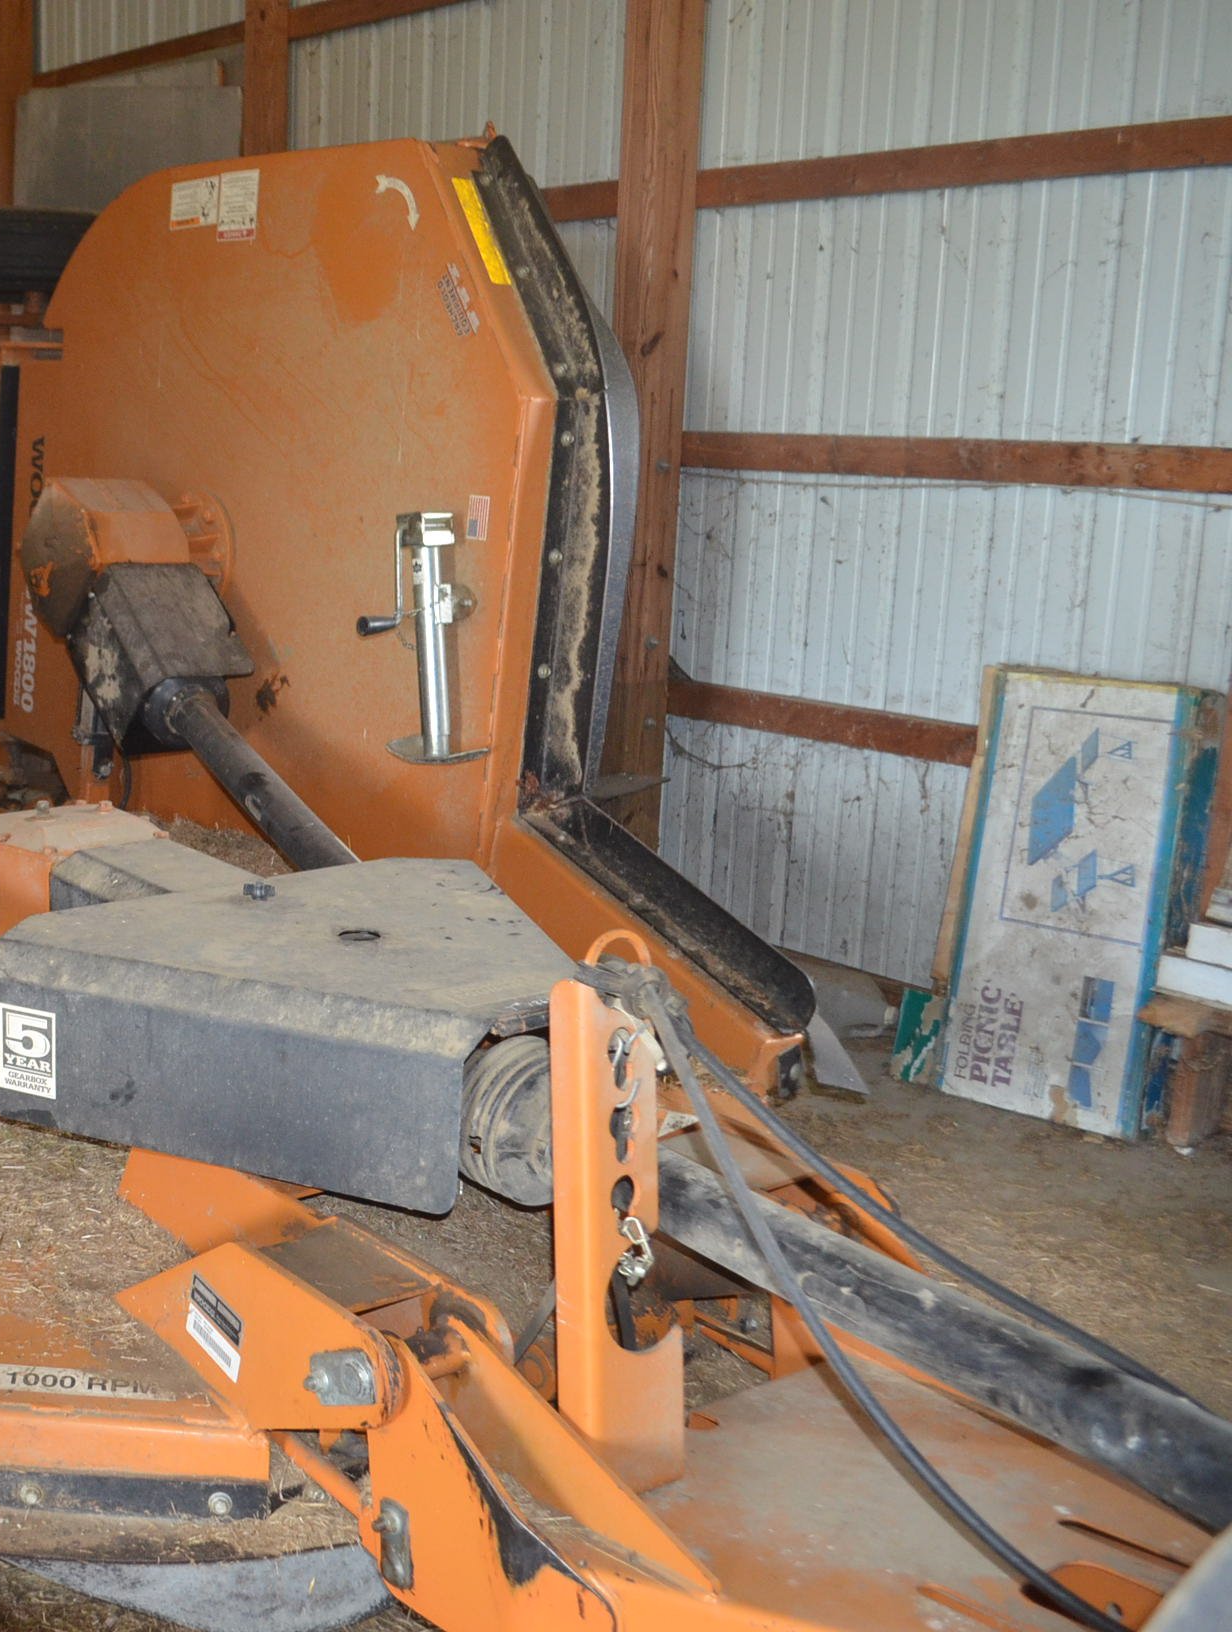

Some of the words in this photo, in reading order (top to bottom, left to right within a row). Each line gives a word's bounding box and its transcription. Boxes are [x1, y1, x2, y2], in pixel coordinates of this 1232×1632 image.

[21, 588, 38, 713] W1800
[5, 1012, 50, 1058] 5
[954, 1002, 976, 1079] FOLDING
[969, 985, 1002, 1085] PICNIC
[991, 997, 1024, 1087] TABLE
[4, 1053, 52, 1073] YEAR
[4, 1078, 52, 1094] WARRANTY
[8, 1071, 47, 1086] GEARBOX
[6, 1371, 76, 1389] 1000
